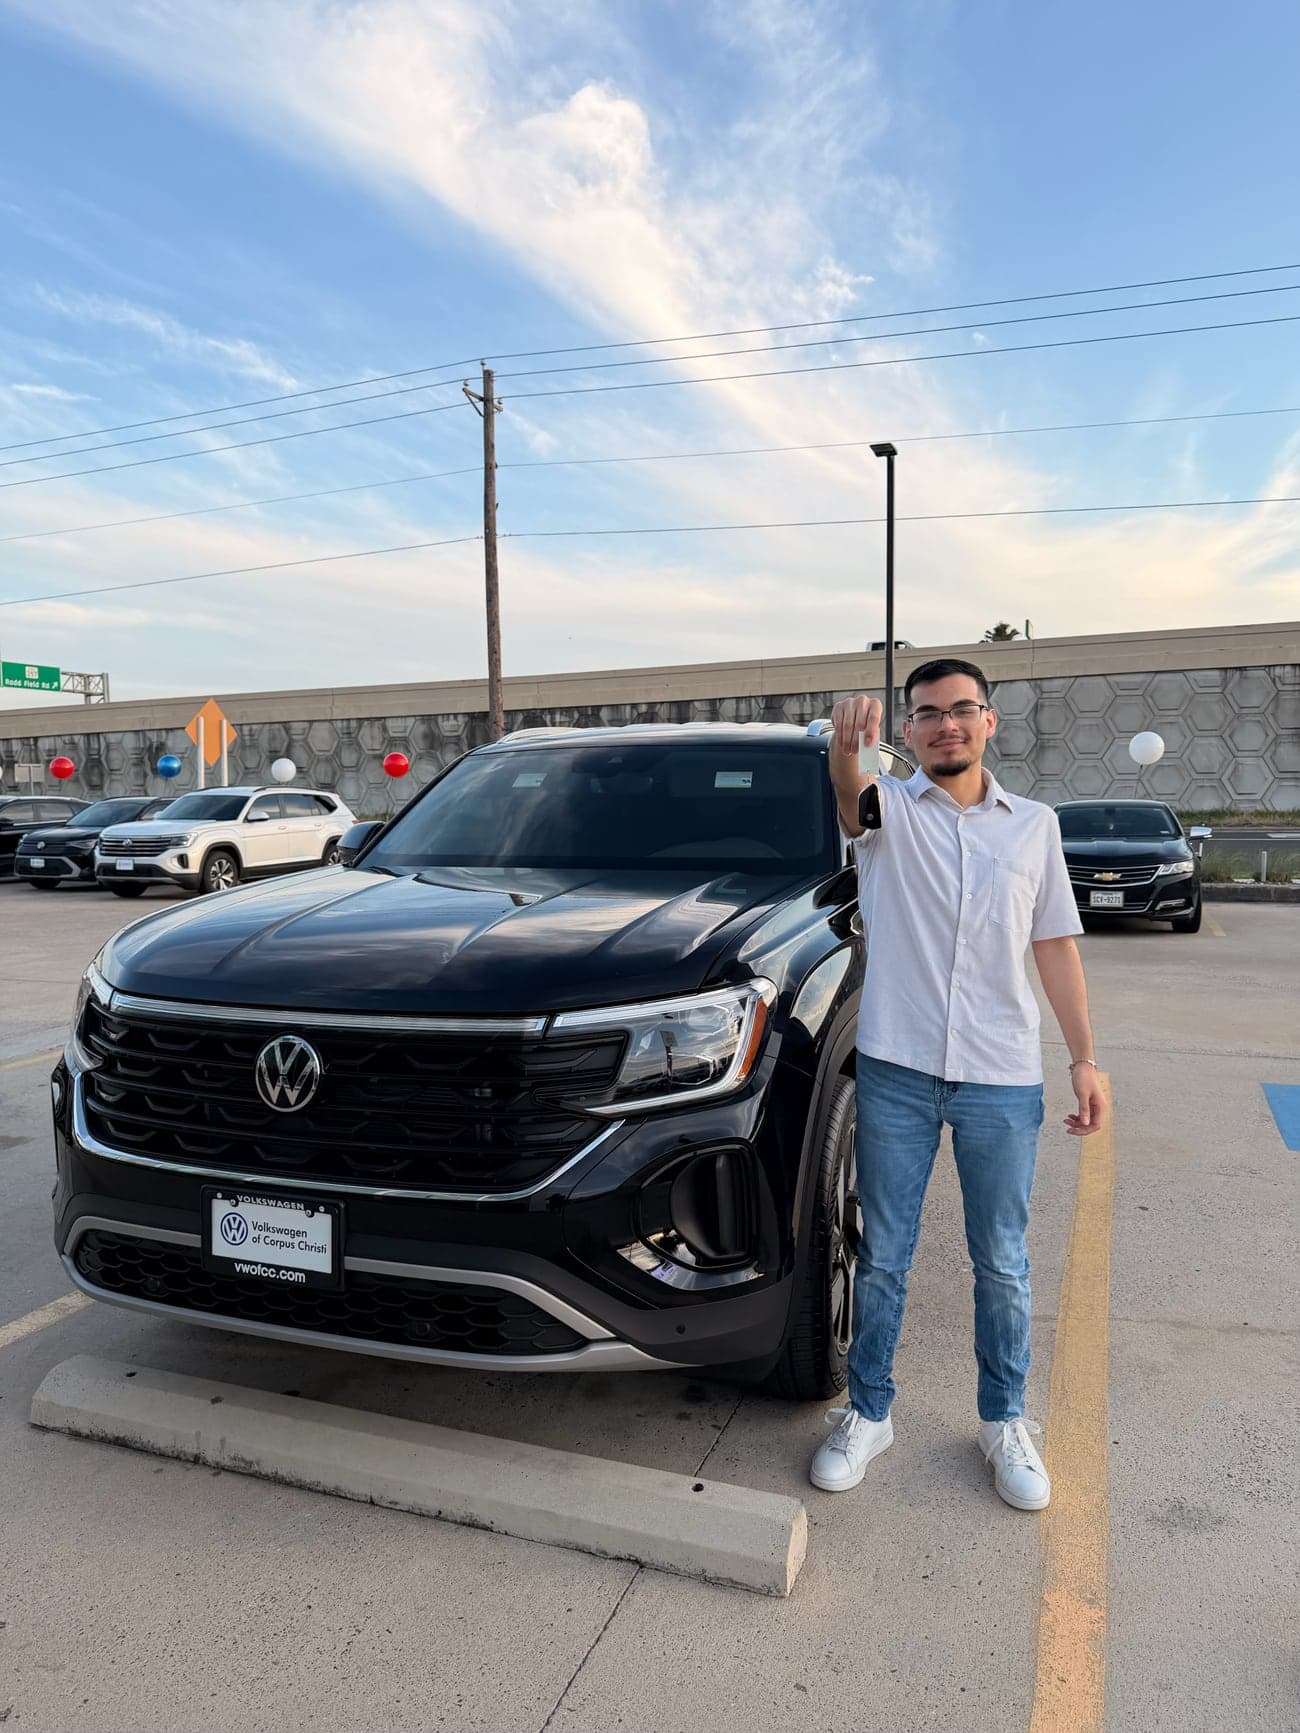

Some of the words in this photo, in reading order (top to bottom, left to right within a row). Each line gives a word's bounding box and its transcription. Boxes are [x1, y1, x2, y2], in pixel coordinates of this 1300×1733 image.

[259, 1037, 317, 1109] VW
[236, 1195, 305, 1210] VOLKSWAGEN
[252, 1221, 308, 1239] Volkswagen
[252, 1234, 261, 1244] of
[263, 1236, 295, 1250] Corpus
[298, 1241, 327, 1254] Christi
[234, 1262, 306, 1283] vwofcc.com
